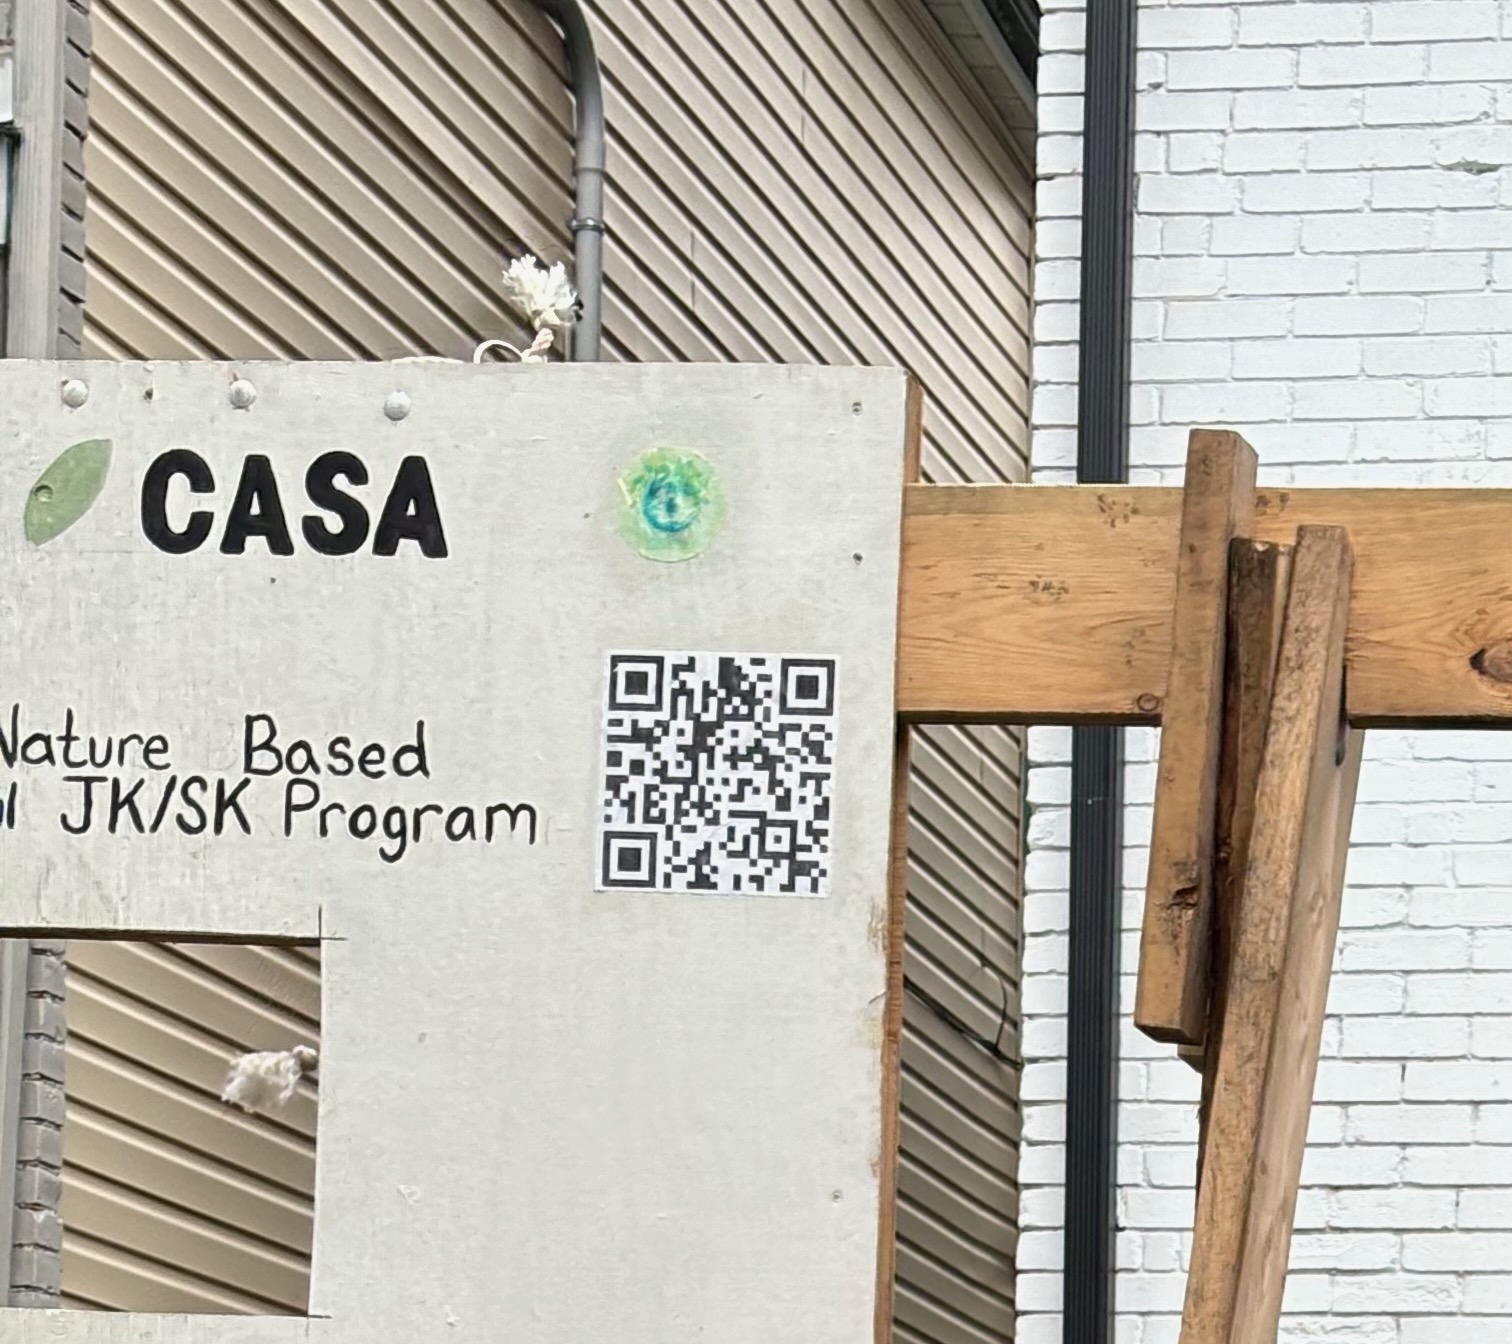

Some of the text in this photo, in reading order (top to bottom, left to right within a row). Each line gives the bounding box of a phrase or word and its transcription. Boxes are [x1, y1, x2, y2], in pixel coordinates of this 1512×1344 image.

[139, 449, 449, 559] CASA
[243, 713, 430, 779] Based
[60, 774, 252, 836] JK/SK
[284, 778, 537, 864] Program
